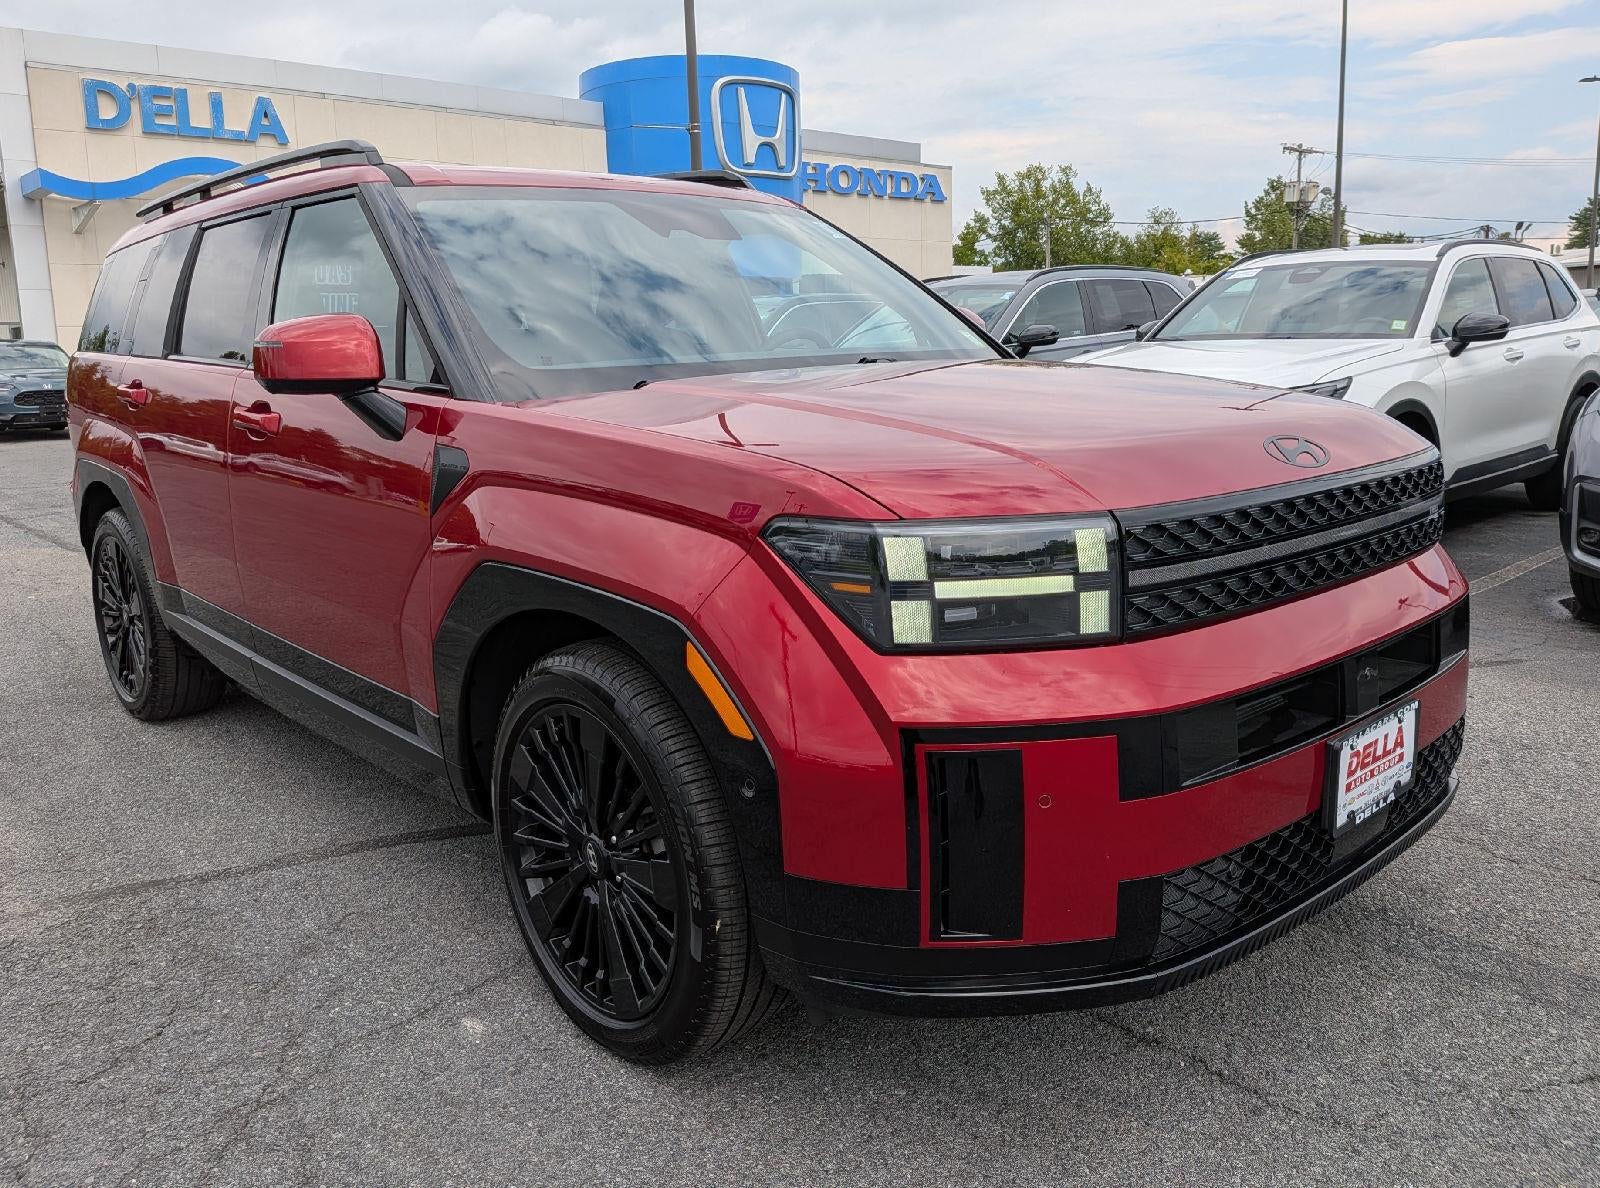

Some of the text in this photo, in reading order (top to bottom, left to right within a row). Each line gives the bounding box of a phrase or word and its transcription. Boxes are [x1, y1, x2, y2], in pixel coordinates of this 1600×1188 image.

[82, 77, 290, 145] D'ELLA
[801, 161, 948, 203] HONDA
[1346, 724, 1404, 780] DELLA
[1350, 770, 1371, 790] AUTO
[1373, 755, 1400, 776] GROUP
[1355, 792, 1396, 824] DELLA
